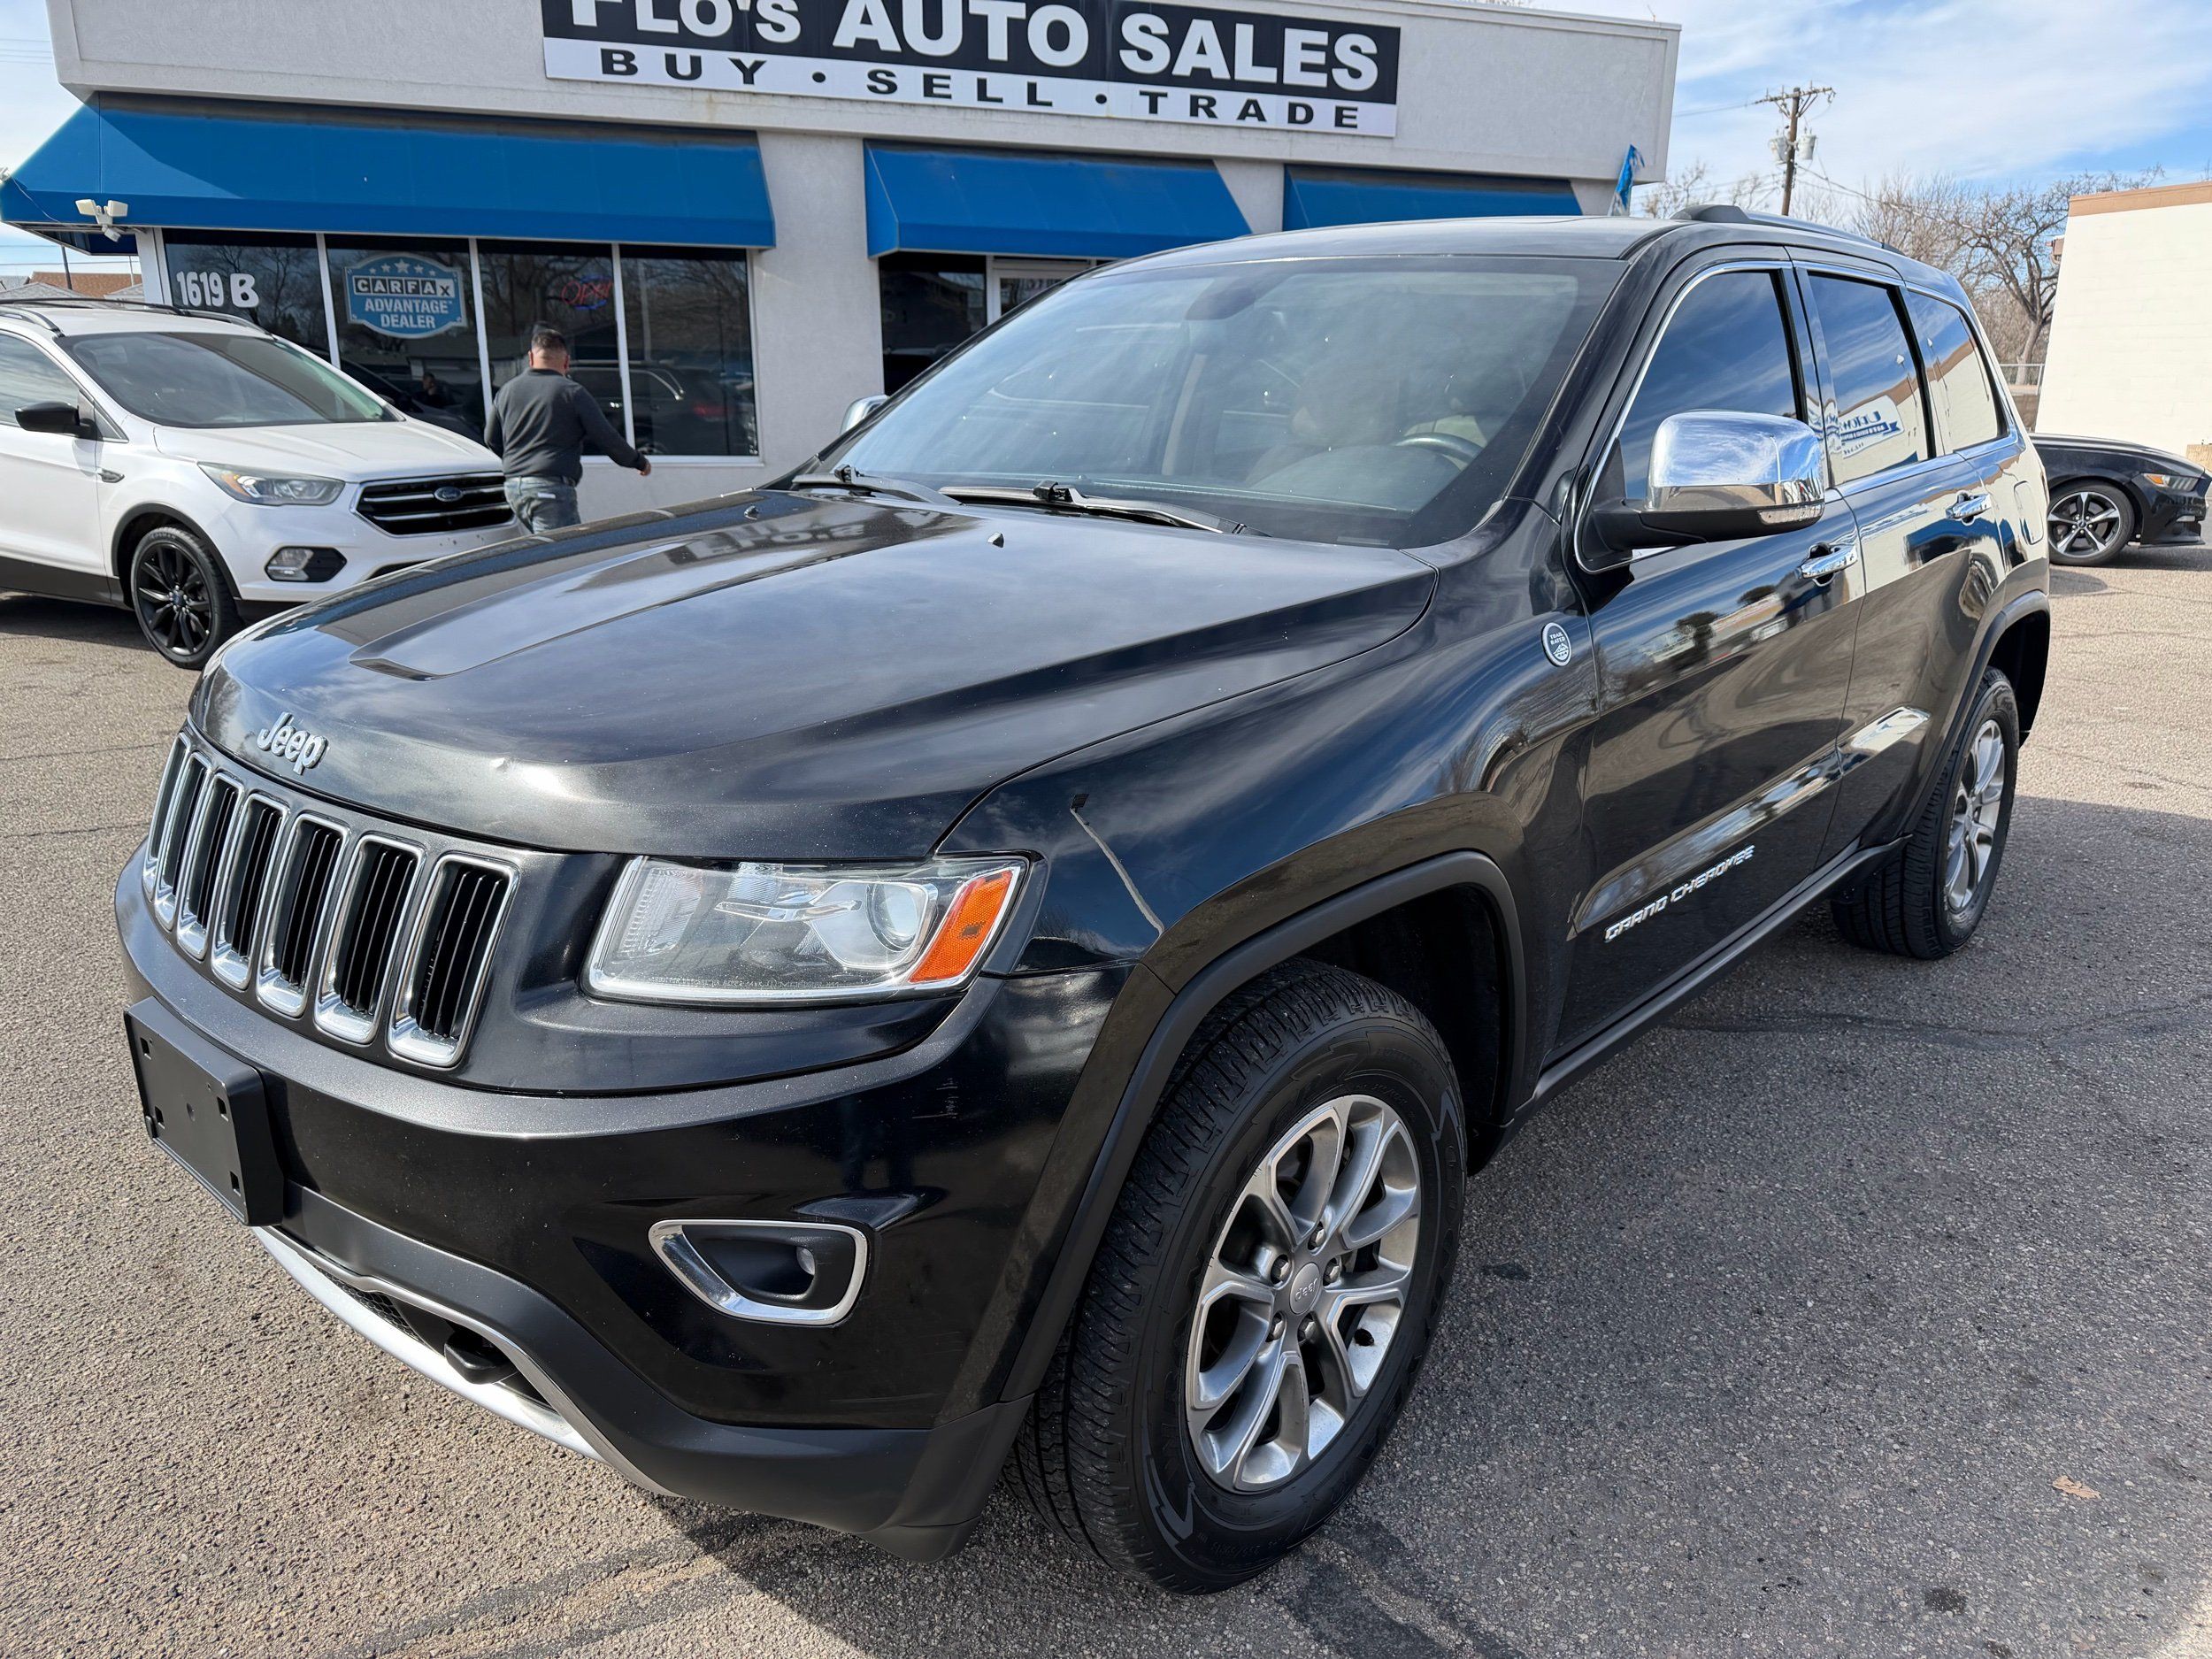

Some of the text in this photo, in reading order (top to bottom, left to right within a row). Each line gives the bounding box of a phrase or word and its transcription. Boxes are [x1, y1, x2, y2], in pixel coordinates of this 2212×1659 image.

[832, 0, 1089, 67] AUTO
[1118, 12, 1379, 92] SALES
[600, 47, 1358, 129] BUY SELL TRADE
[176, 271, 259, 308] 1619 B
[356, 279, 450, 296] CARFAX
[380, 313, 436, 328] DEALER
[1550, 636, 1566, 646] RATED
[257, 711, 328, 776] Jeep
[1604, 844, 1755, 942] GRAND CHEROKEE
